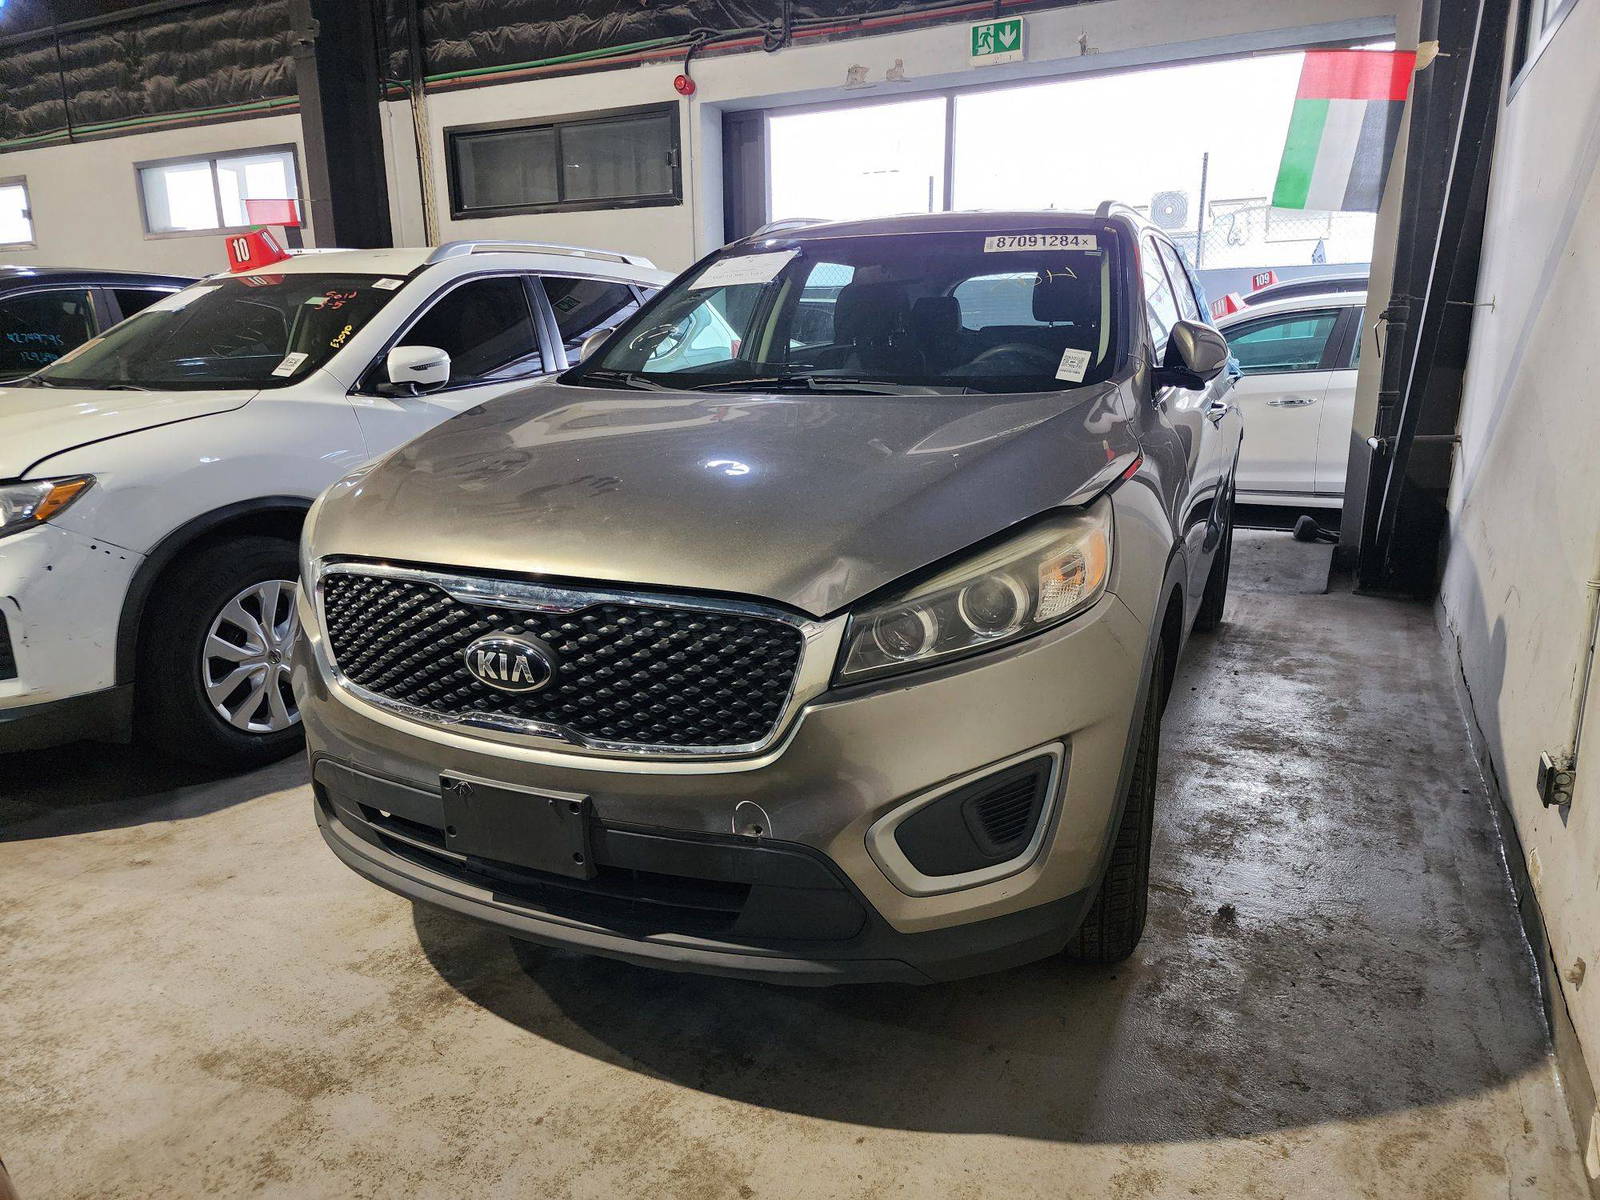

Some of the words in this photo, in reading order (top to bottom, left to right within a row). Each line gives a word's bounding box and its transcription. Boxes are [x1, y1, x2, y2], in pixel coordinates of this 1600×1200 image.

[233, 238, 250, 262] 10
[1256, 272, 1270, 287] 109
[477, 649, 535, 683] KIA
